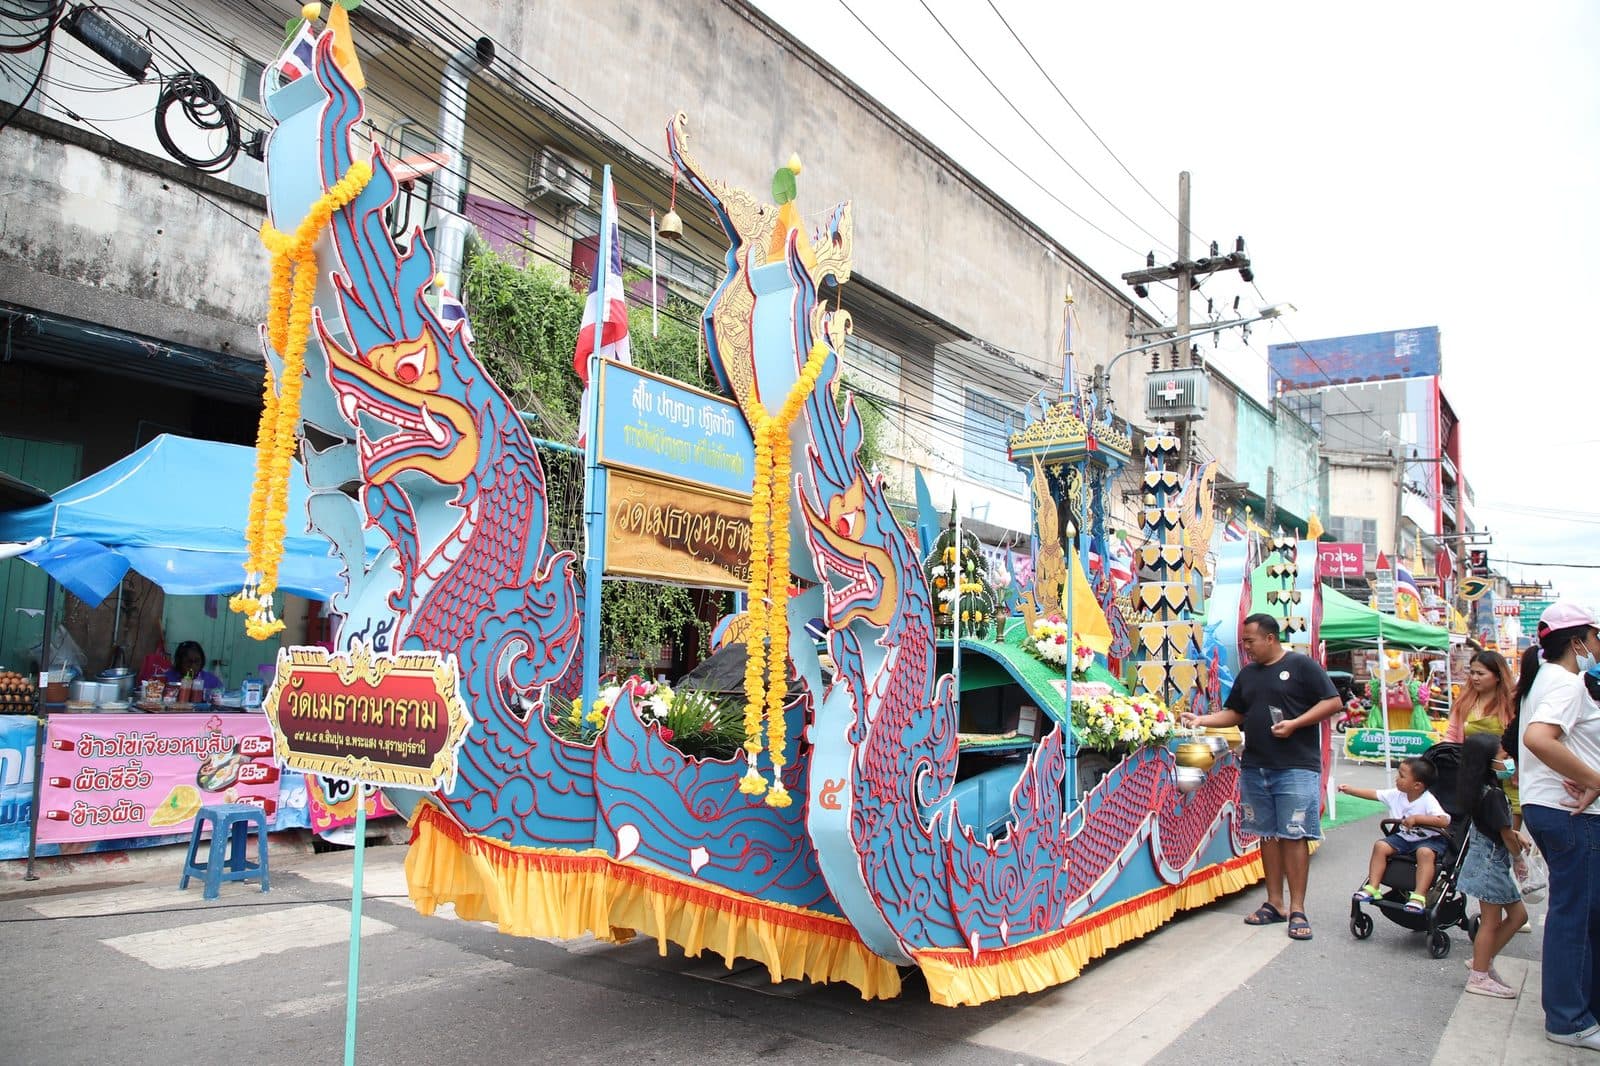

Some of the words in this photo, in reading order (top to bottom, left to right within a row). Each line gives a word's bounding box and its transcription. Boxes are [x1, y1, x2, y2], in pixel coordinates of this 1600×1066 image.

[287, 676, 438, 730] วัดเมธาวนาราม
[79, 732, 234, 760] ข้าวไข่เจียวหมูสับ
[378, 737, 426, 758] จ.สุราษฎร์ธานี
[72, 800, 145, 825] ข้าวผัด
